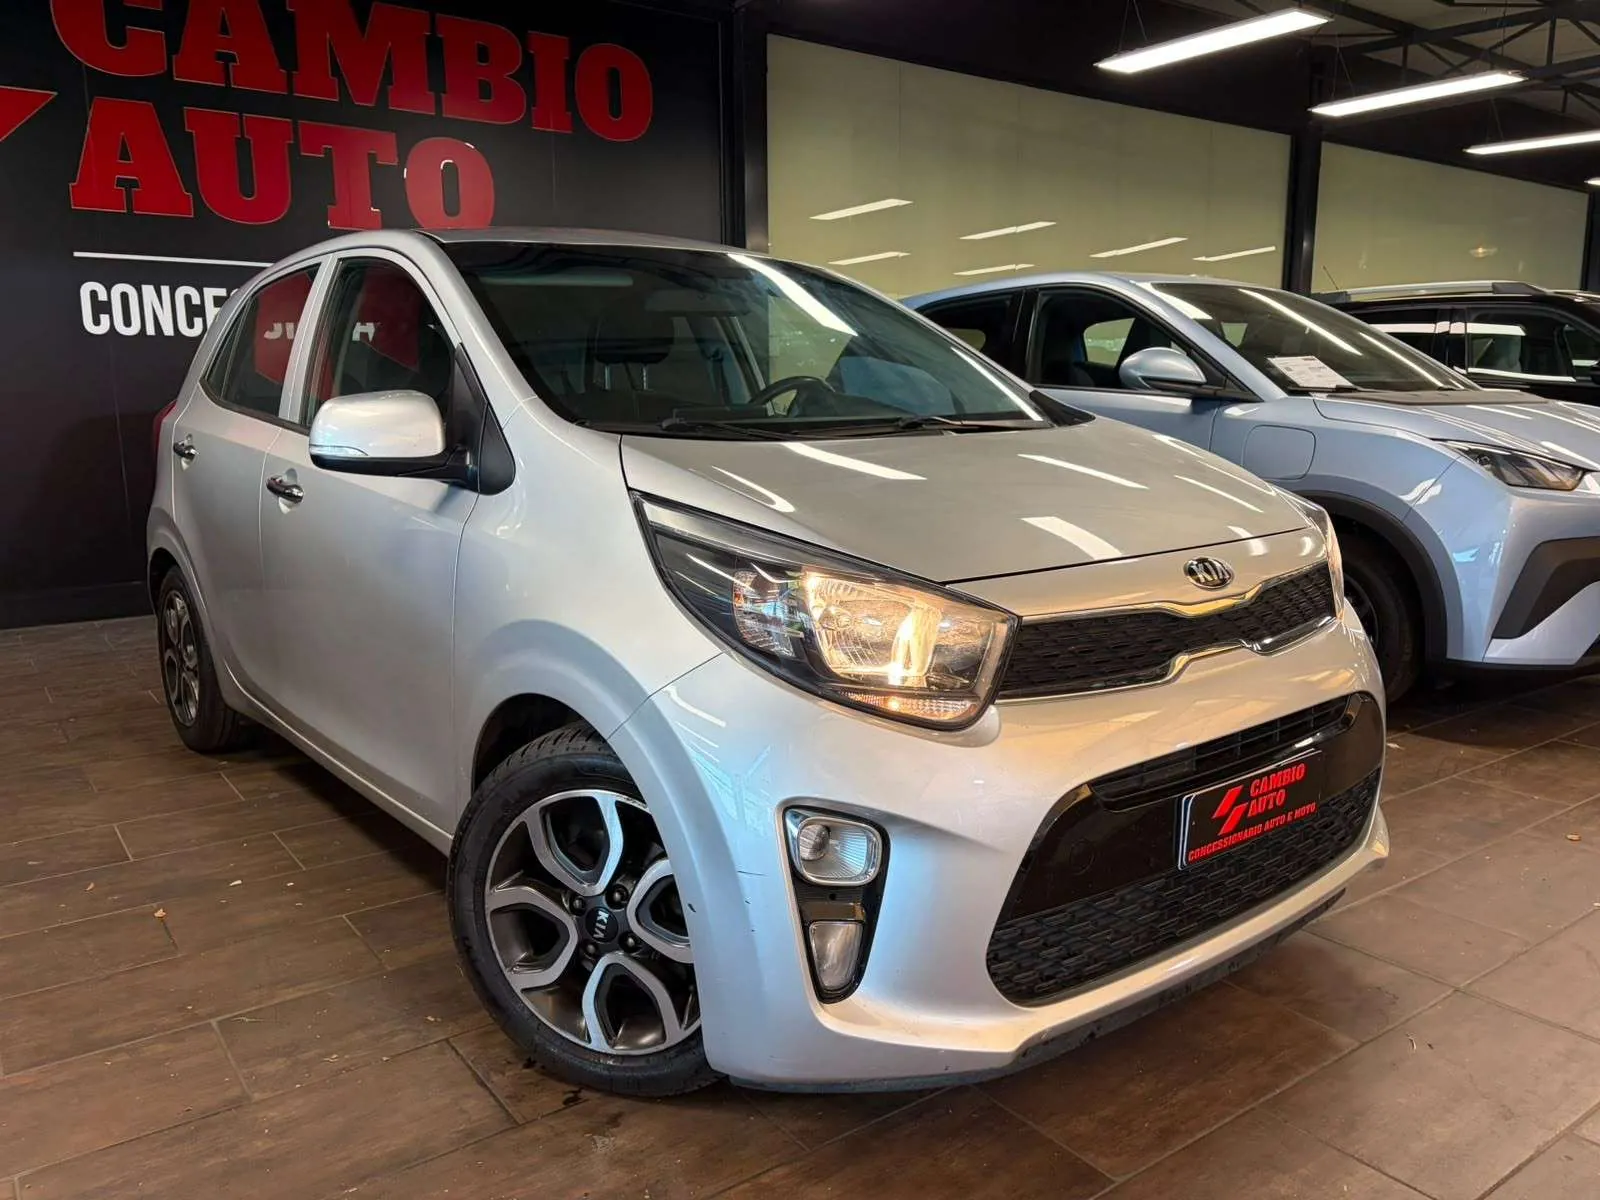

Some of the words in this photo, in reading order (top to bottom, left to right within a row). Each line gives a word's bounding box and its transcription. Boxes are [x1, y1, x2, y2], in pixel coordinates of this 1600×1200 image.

[50, 0, 653, 142] CAMBIO
[69, 96, 495, 230] AUTO
[79, 281, 239, 338] CONCE
[1188, 558, 1231, 584] KIA
[1249, 763, 1306, 797] CAMBIO
[1247, 789, 1286, 818] AUTO
[1188, 823, 1262, 862] CONCESSIONARIO
[1264, 814, 1286, 832] AUTO
[1294, 802, 1317, 820] MOTO
[593, 910, 609, 939] KIA
